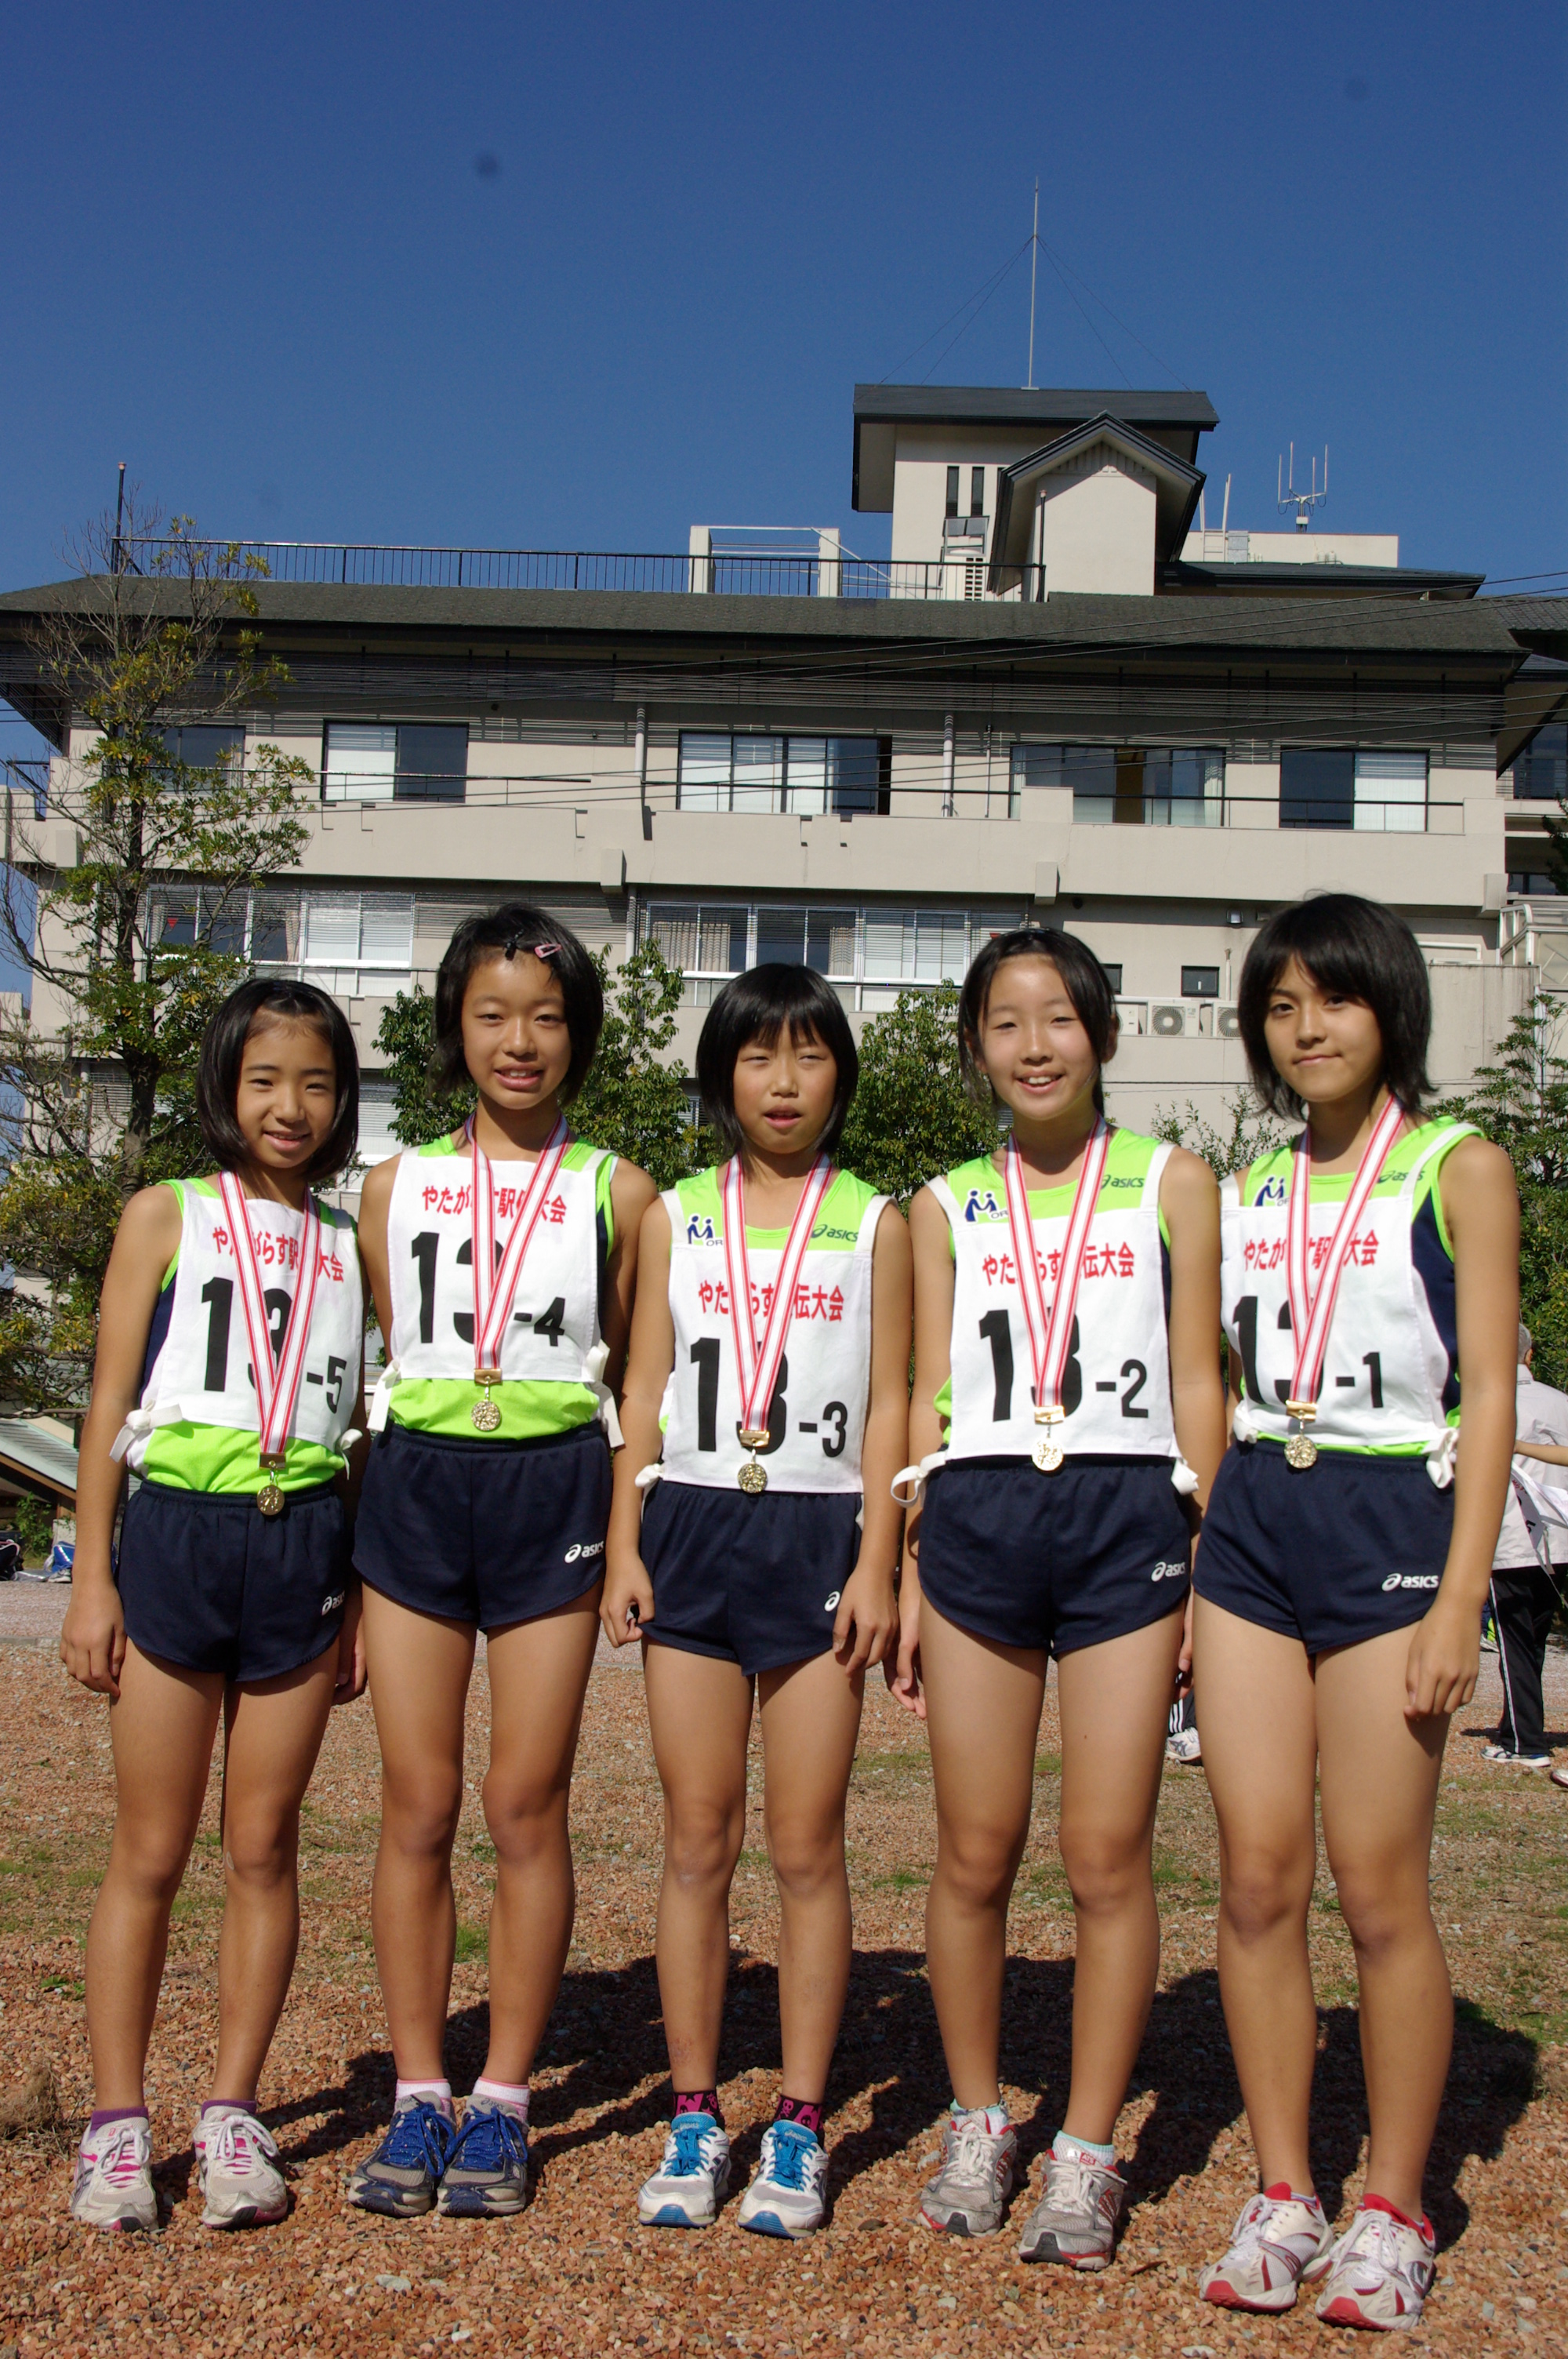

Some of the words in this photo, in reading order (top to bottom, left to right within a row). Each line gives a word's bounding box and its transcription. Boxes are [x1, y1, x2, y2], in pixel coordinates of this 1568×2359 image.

[1111, 1176, 1145, 1188] asics
[1392, 1171, 1425, 1182] ass
[212, 1226, 344, 1284] やらす駅大会
[826, 1227, 858, 1243] asics
[1243, 1229, 1379, 1272] やたが駅大会
[982, 1241, 1134, 1287] やたらす伝大会
[698, 1280, 844, 1322] やたらす伝大会
[1232, 1296, 1384, 1408] 1-1
[1400, 1575, 1439, 1589] asics
